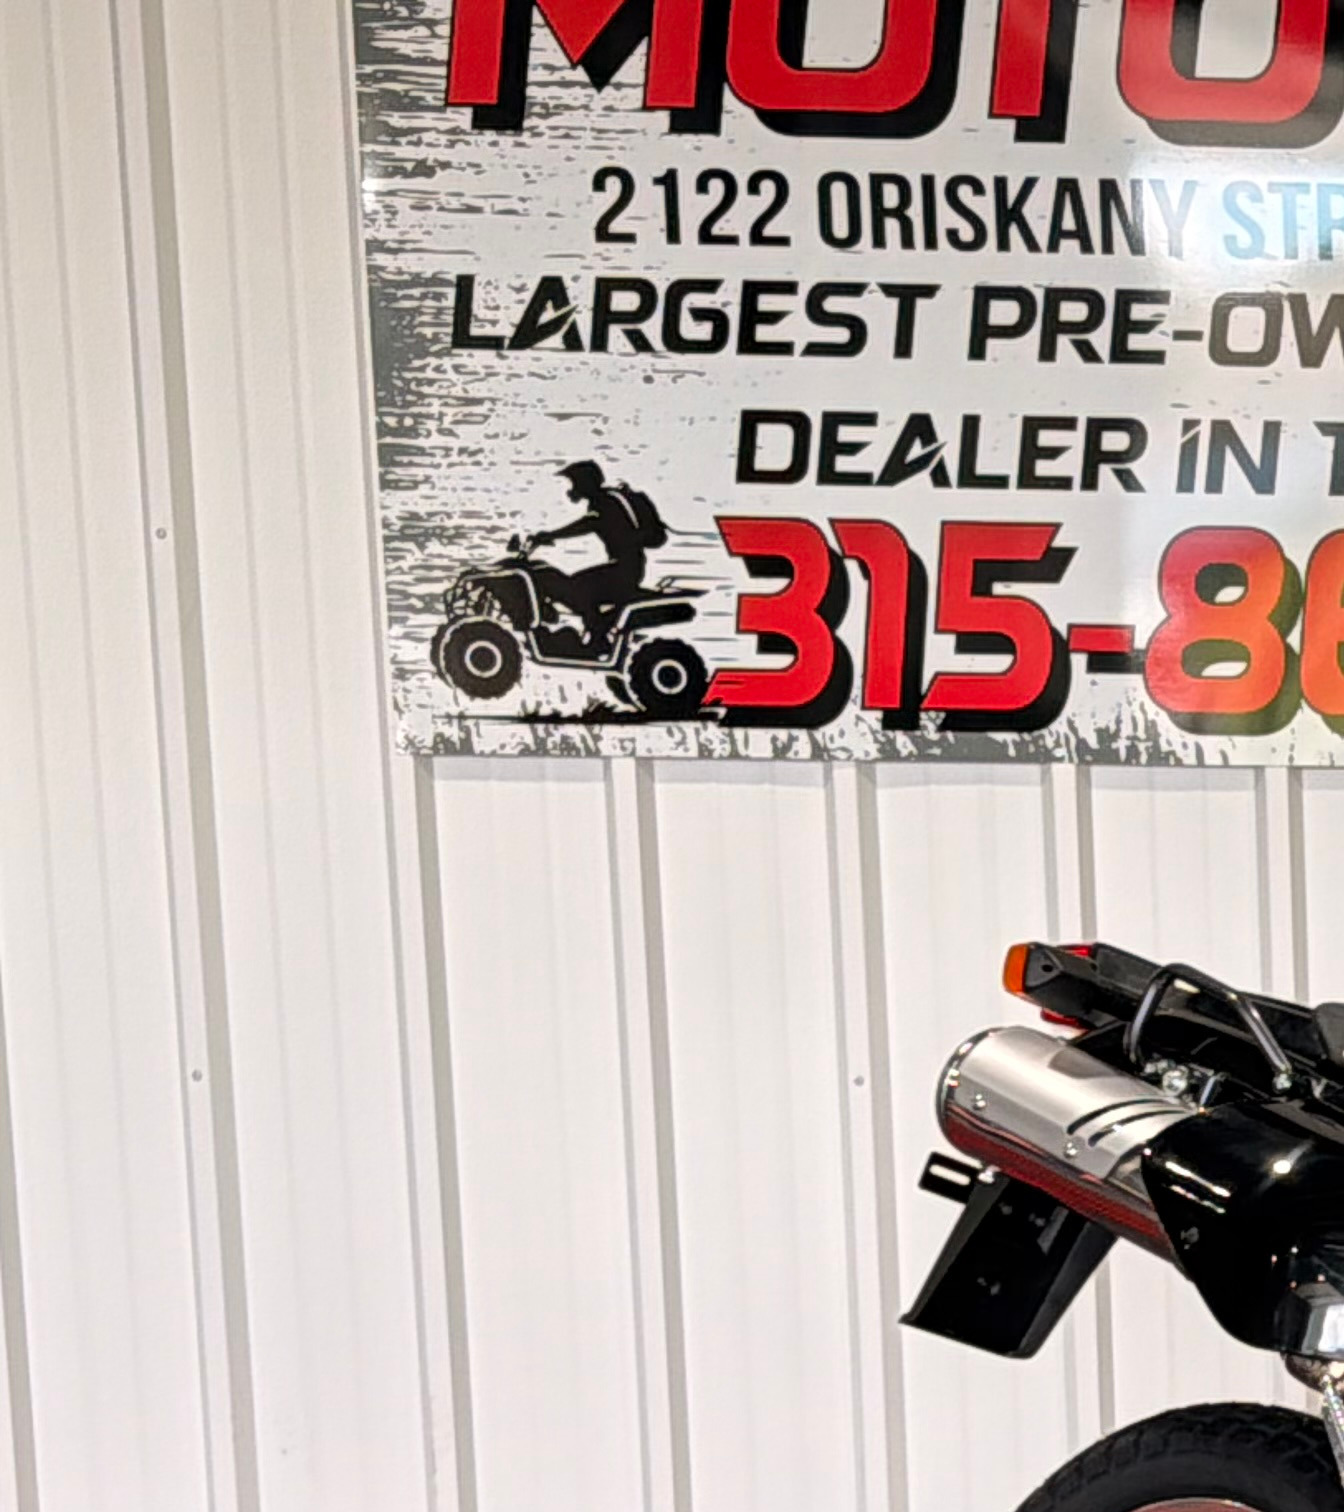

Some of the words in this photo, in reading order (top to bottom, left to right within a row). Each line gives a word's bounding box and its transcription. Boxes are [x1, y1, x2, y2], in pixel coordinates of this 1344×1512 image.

[590, 166, 792, 247] 2122
[817, 170, 1199, 260] ORISKANY
[451, 273, 942, 360] LARGEST
[734, 408, 1150, 494] DEALER
[1174, 419, 1282, 497] IN
